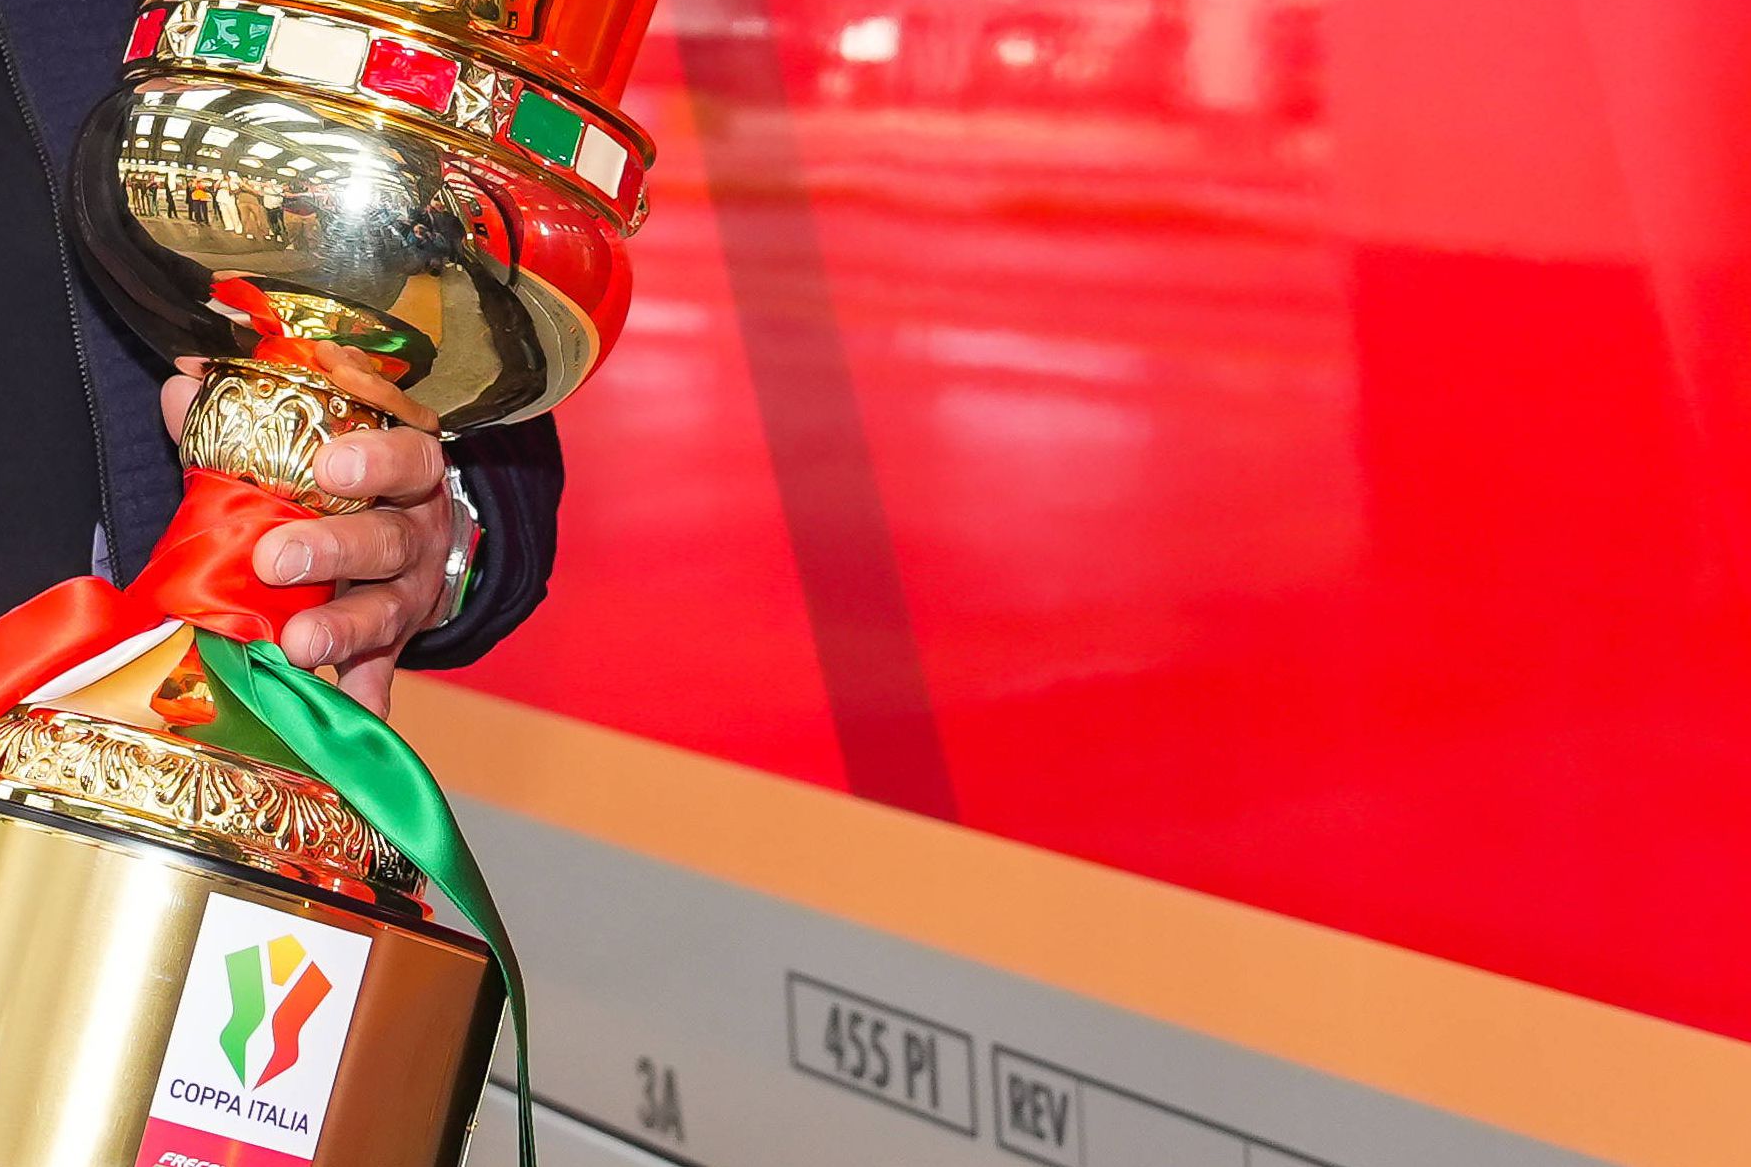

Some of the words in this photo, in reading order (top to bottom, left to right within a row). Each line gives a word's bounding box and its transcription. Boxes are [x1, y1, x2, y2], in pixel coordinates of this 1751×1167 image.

[824, 1002, 890, 1088] 455
[170, 1078, 241, 1117] COPPA
[247, 1099, 308, 1135] ITALIA
[636, 1055, 686, 1143] 3A
[1007, 1072, 1069, 1148] REV
